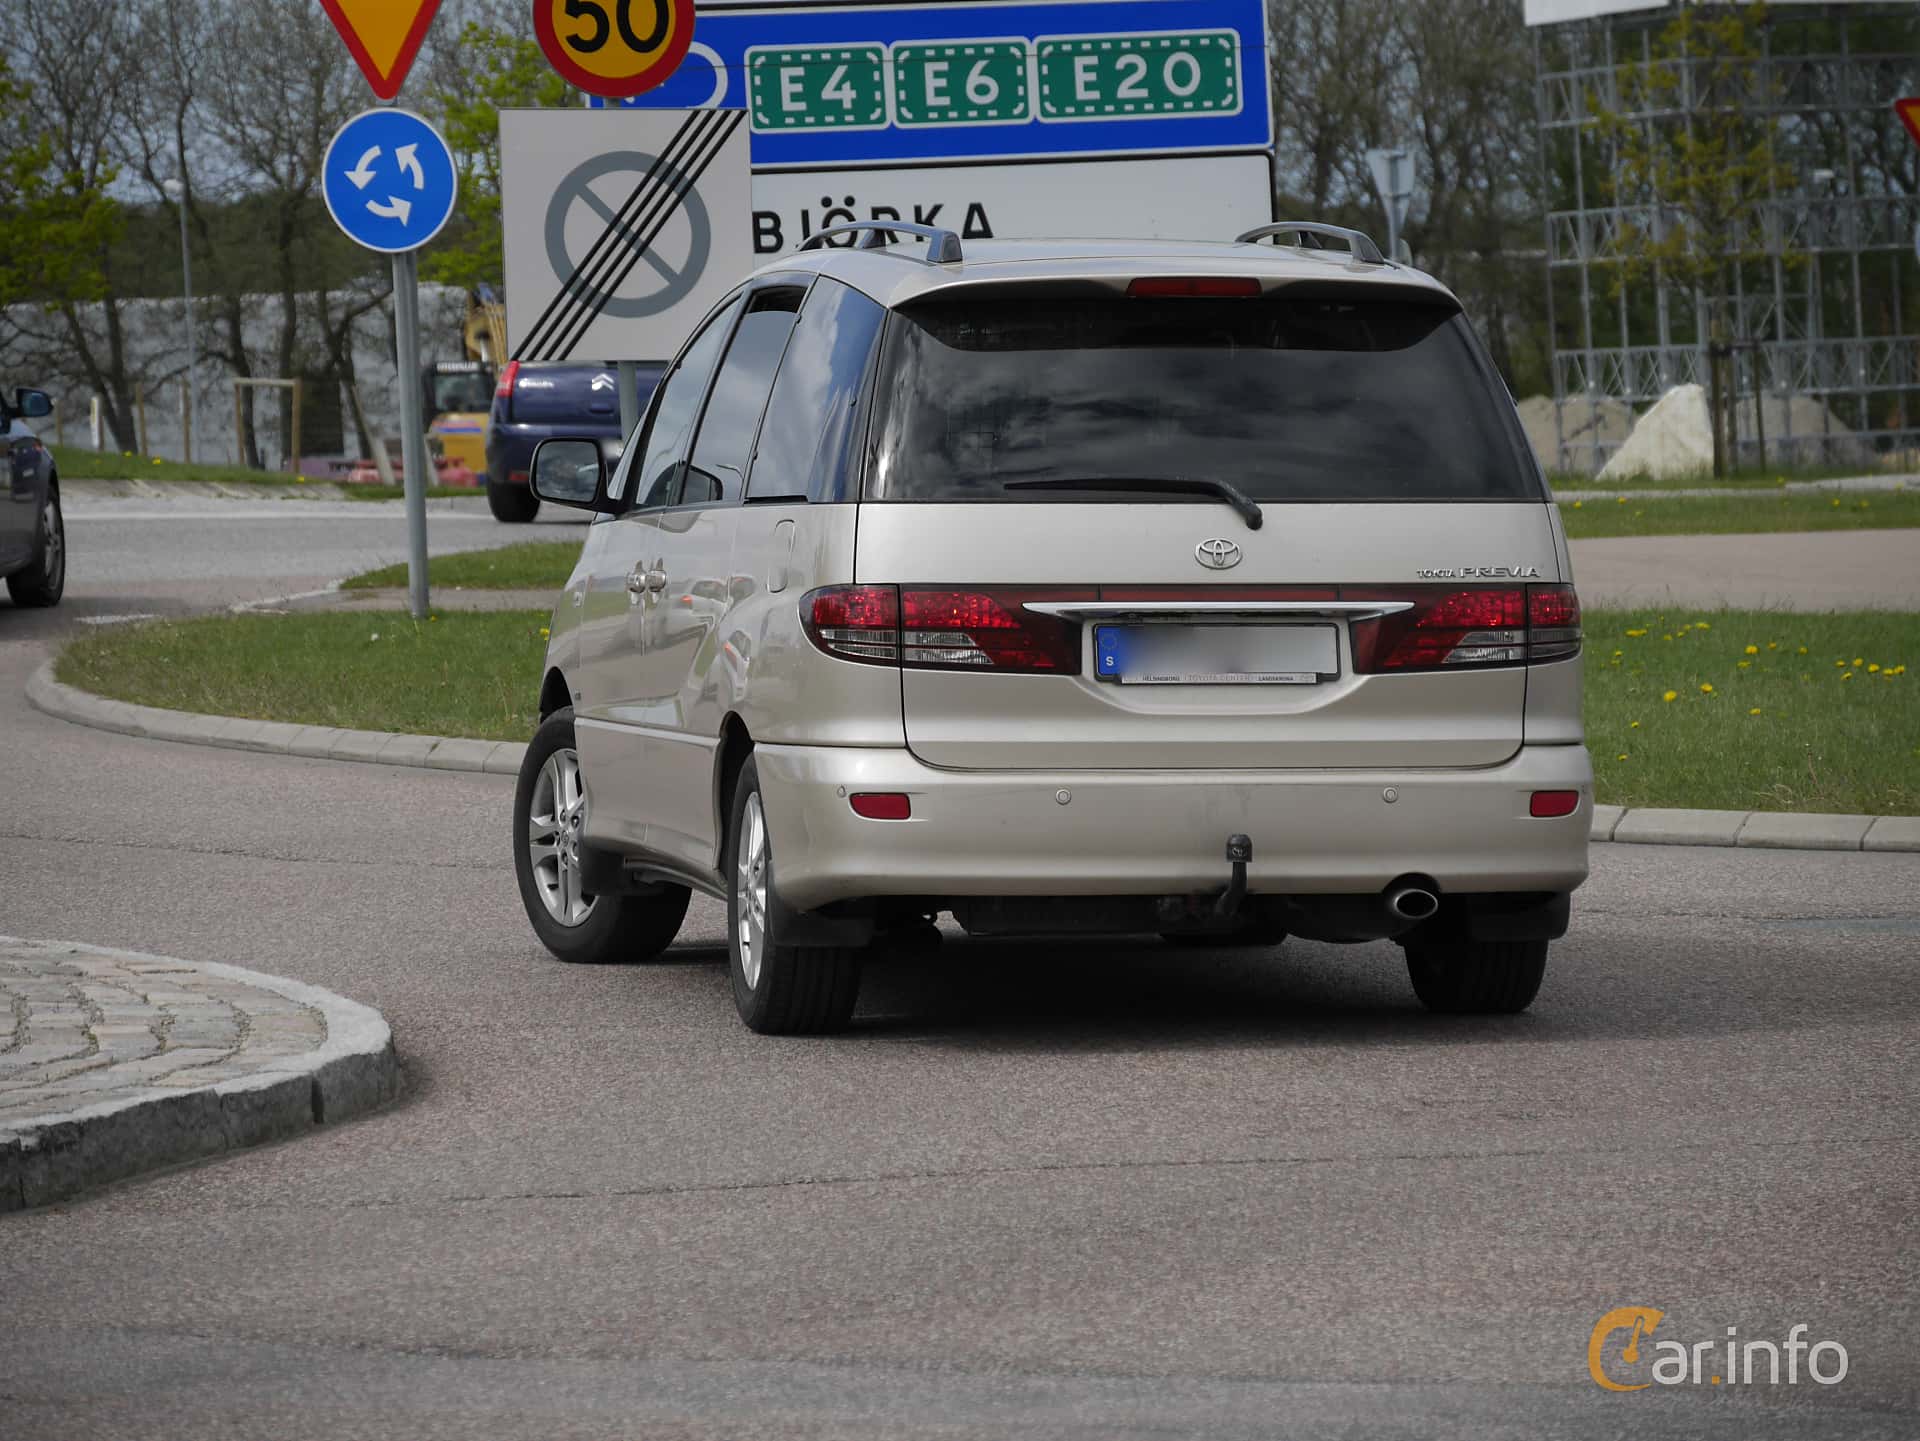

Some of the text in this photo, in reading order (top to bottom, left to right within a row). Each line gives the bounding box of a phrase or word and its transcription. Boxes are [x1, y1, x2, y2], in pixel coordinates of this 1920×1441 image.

[565, 0, 669, 53] 50
[780, 64, 857, 111] E4
[924, 59, 1000, 106] E6
[1074, 51, 1201, 101] E20
[1416, 566, 1540, 578] TOYOTA PREVIA
[1105, 656, 1114, 667] S
